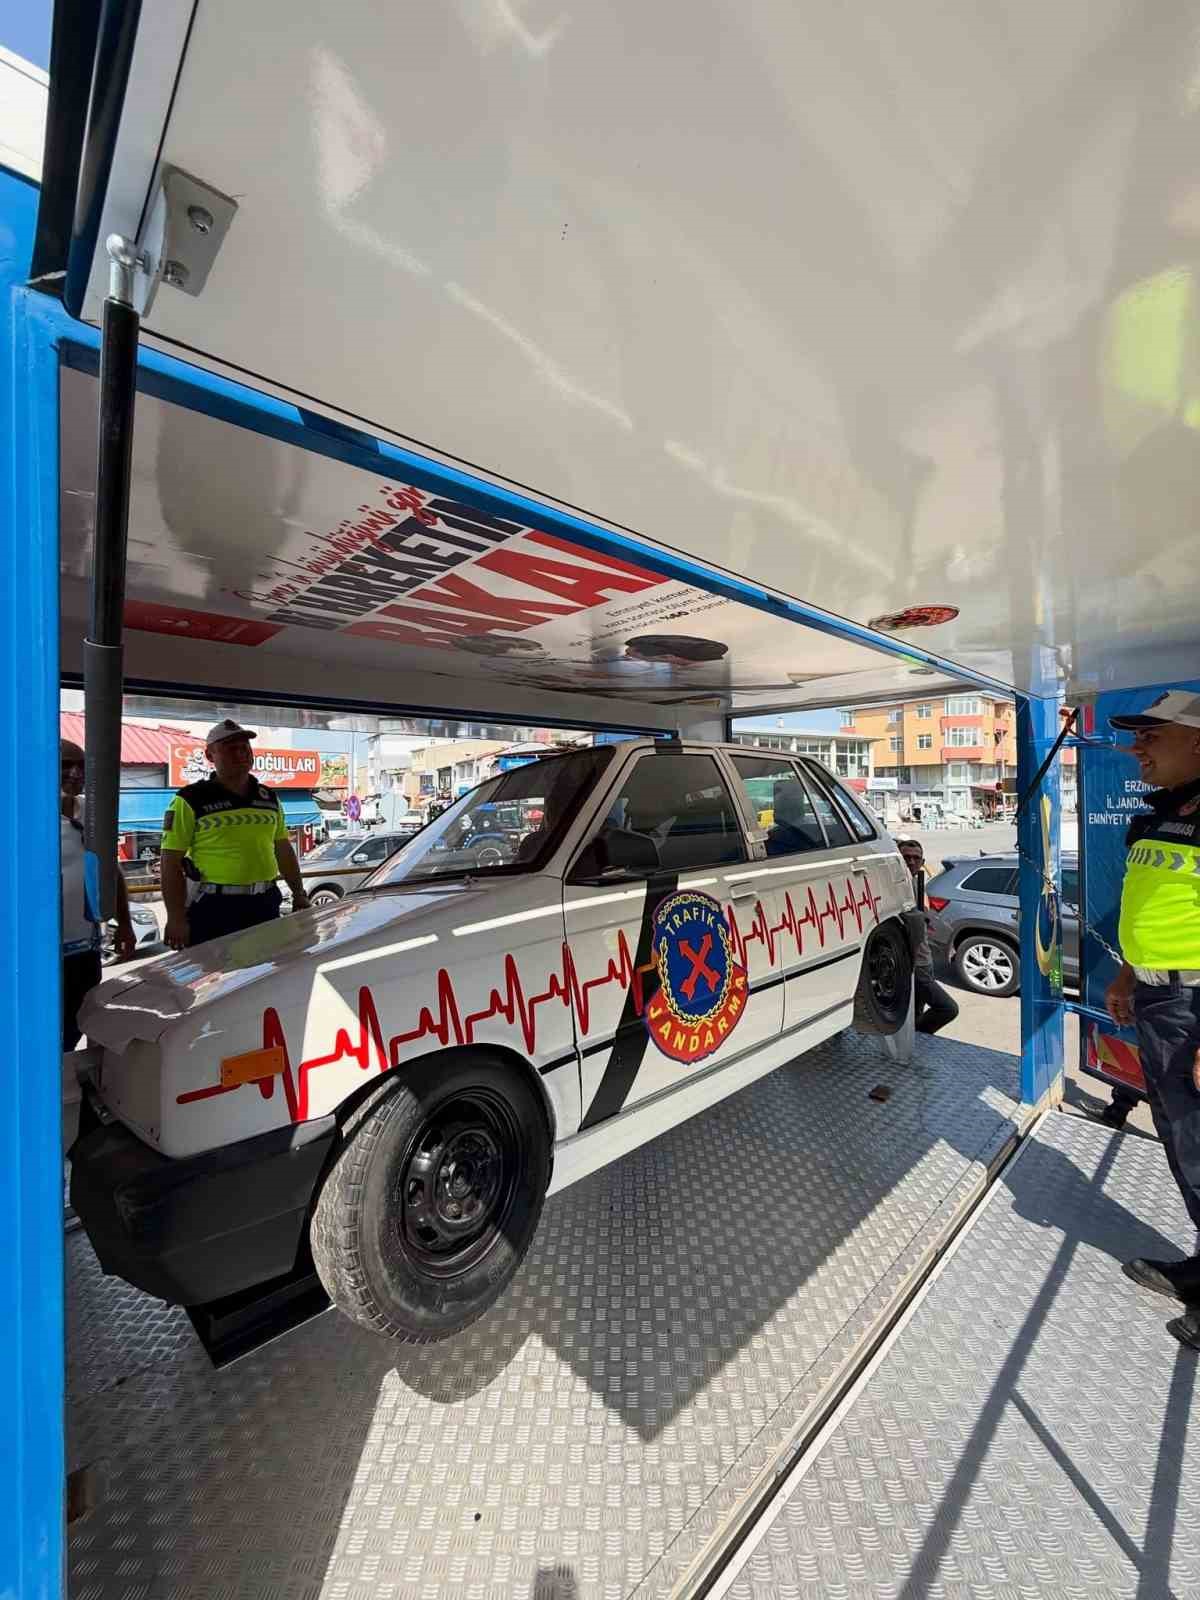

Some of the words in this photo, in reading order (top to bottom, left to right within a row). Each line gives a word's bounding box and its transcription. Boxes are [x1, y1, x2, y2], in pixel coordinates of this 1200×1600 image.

[1088, 811, 1124, 825] EMNİYET
[664, 907, 716, 935] TRAFİK
[649, 975, 746, 1053] JANDARMA
